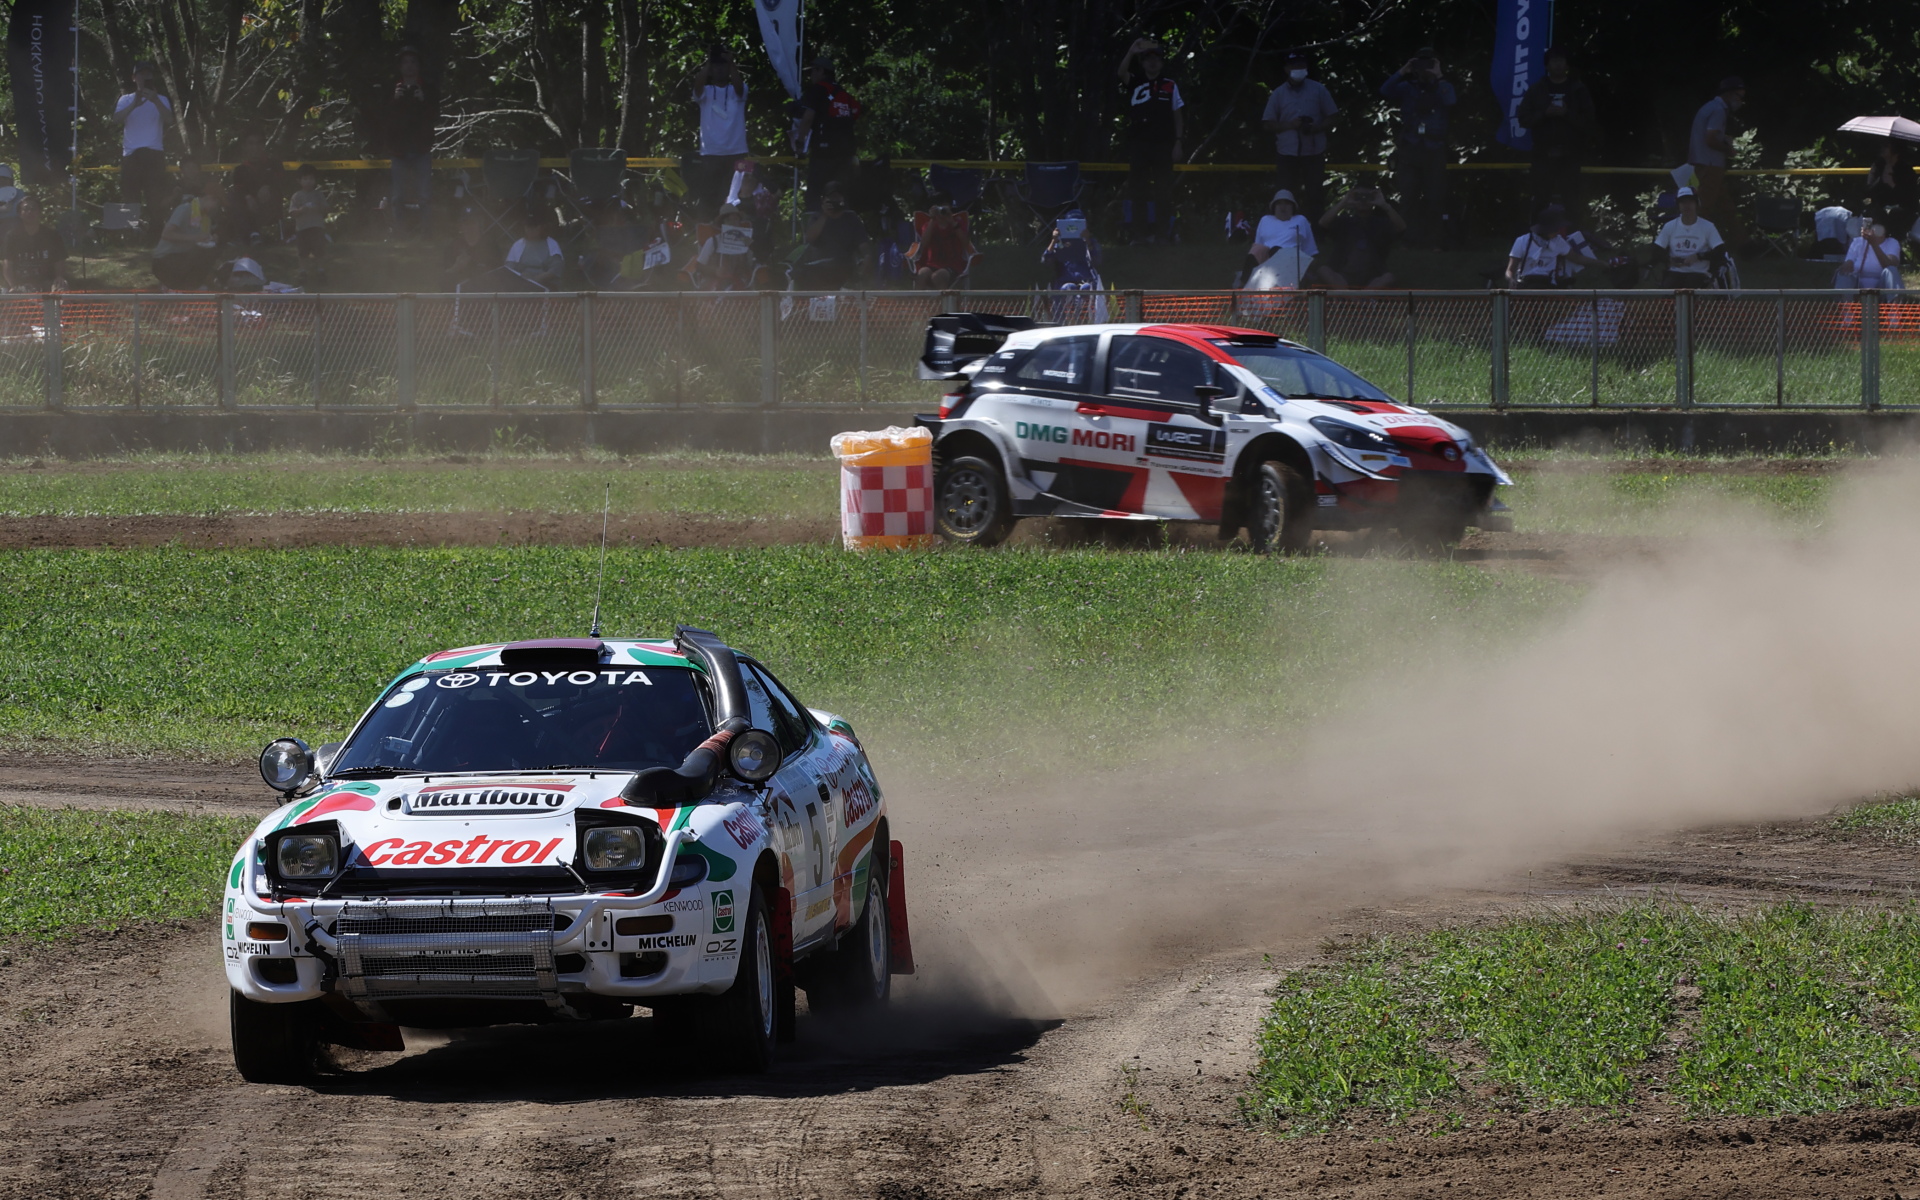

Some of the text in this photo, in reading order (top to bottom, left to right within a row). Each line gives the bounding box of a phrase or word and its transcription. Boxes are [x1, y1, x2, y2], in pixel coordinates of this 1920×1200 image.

[1016, 421, 1136, 452] DMG MORI
[1156, 429, 1202, 446] WRC
[486, 670, 653, 687] TOYOTA
[412, 789, 565, 809] Marlboro
[841, 772, 873, 829] Castrol
[723, 805, 764, 850] Castrol
[355, 834, 565, 867] Castrol
[805, 802, 824, 887] 5
[663, 899, 704, 912] KENWOOD
[717, 906, 732, 917] Castrol
[237, 942, 271, 955] MICHELIN
[639, 934, 697, 949] MICHELIN
